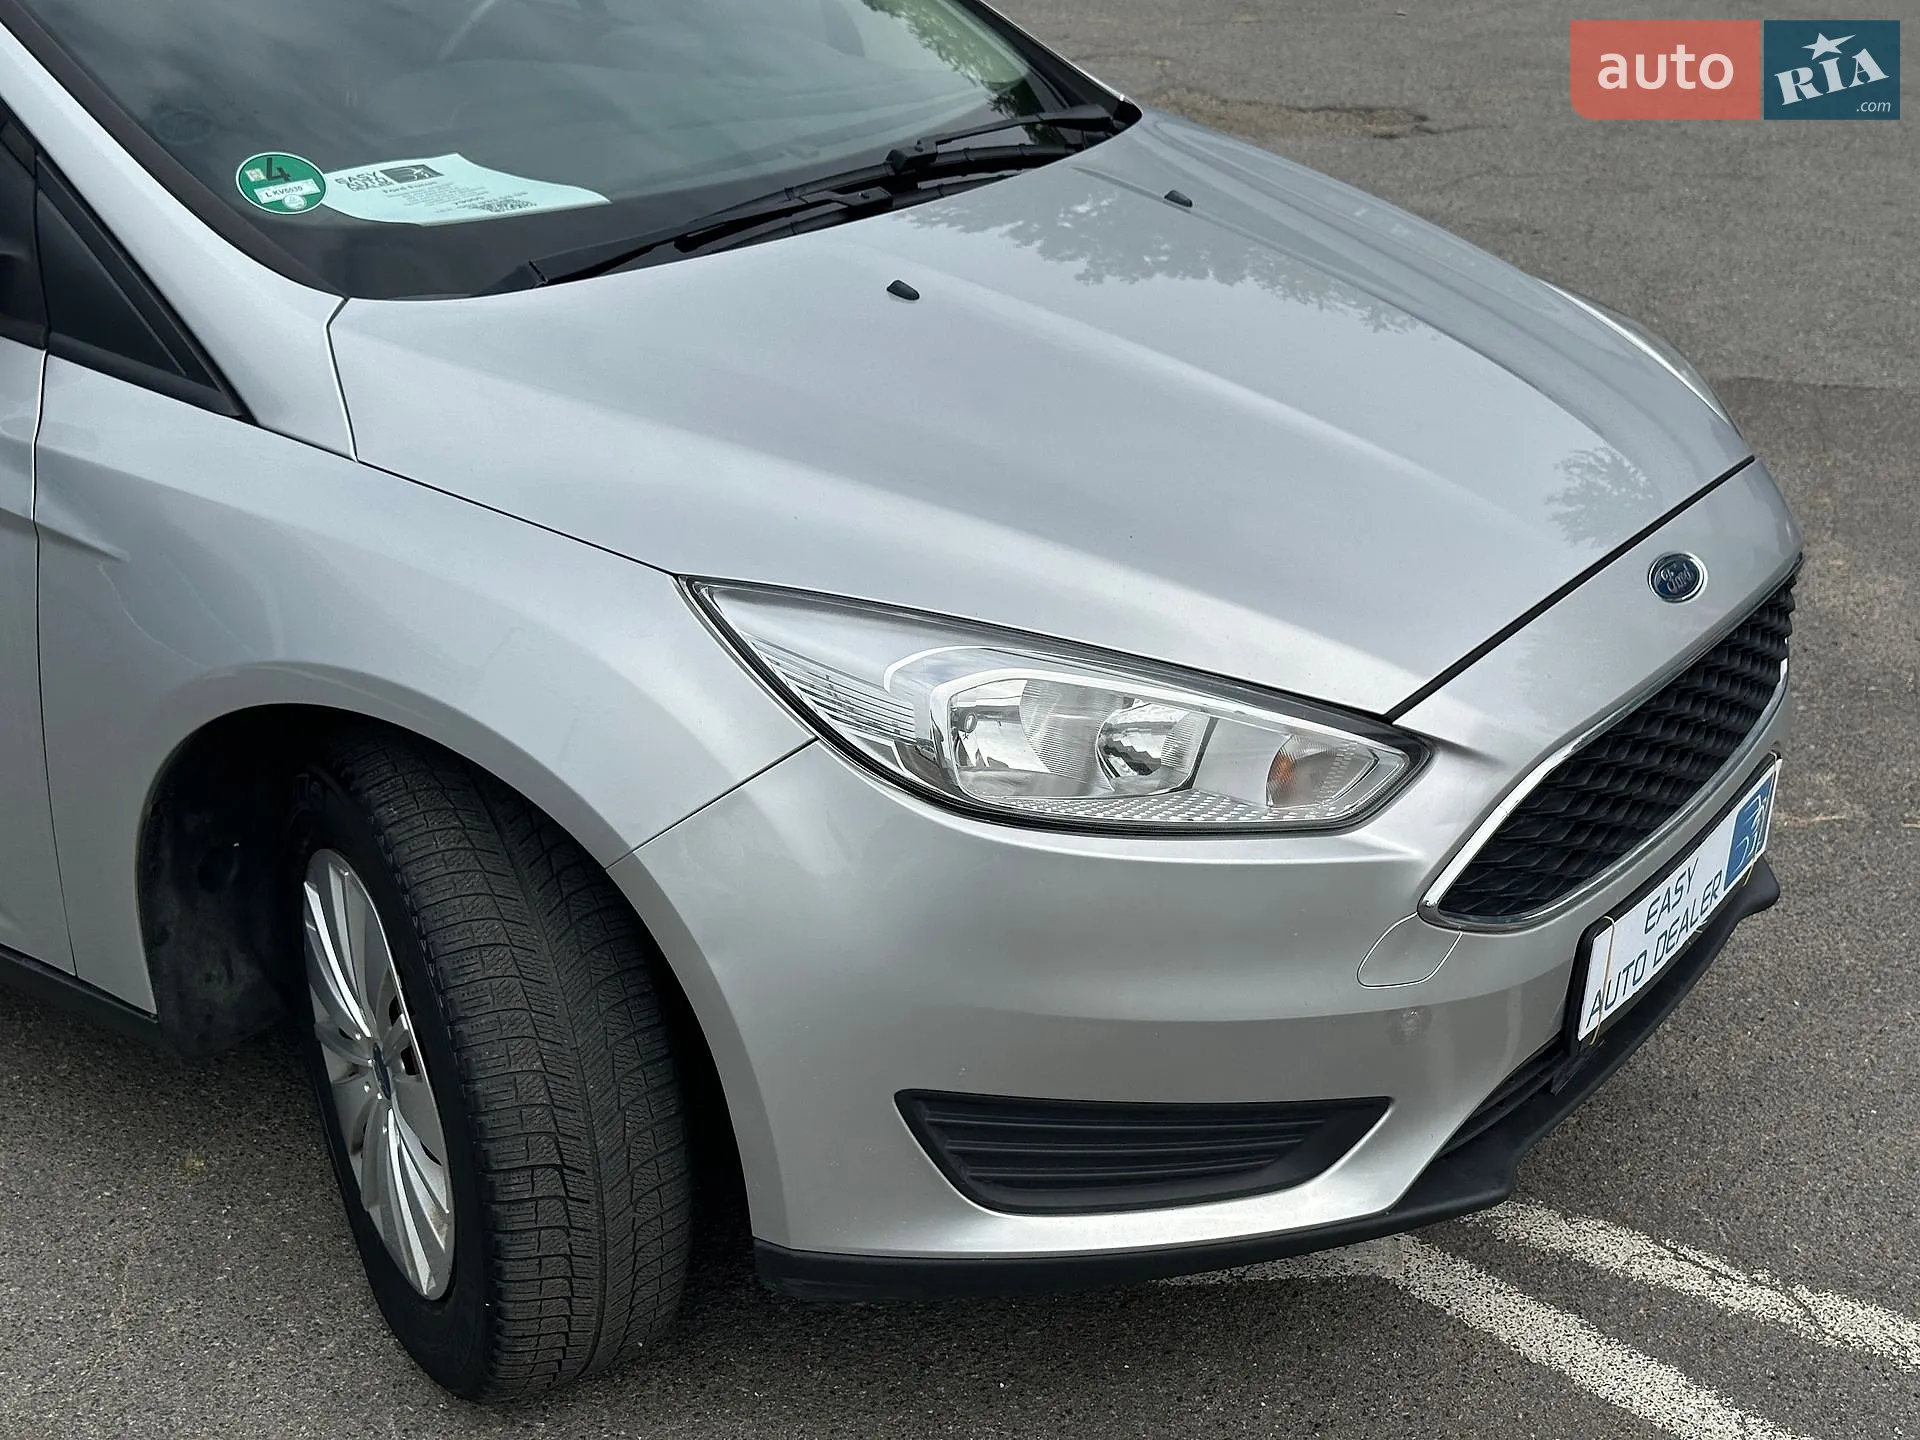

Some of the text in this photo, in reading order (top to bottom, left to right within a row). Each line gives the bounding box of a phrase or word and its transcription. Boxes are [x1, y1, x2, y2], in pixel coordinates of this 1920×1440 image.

[266, 157, 292, 182] 4
[1645, 857, 1699, 935] EASY
[1586, 870, 1726, 1029] AUTO DEALER
